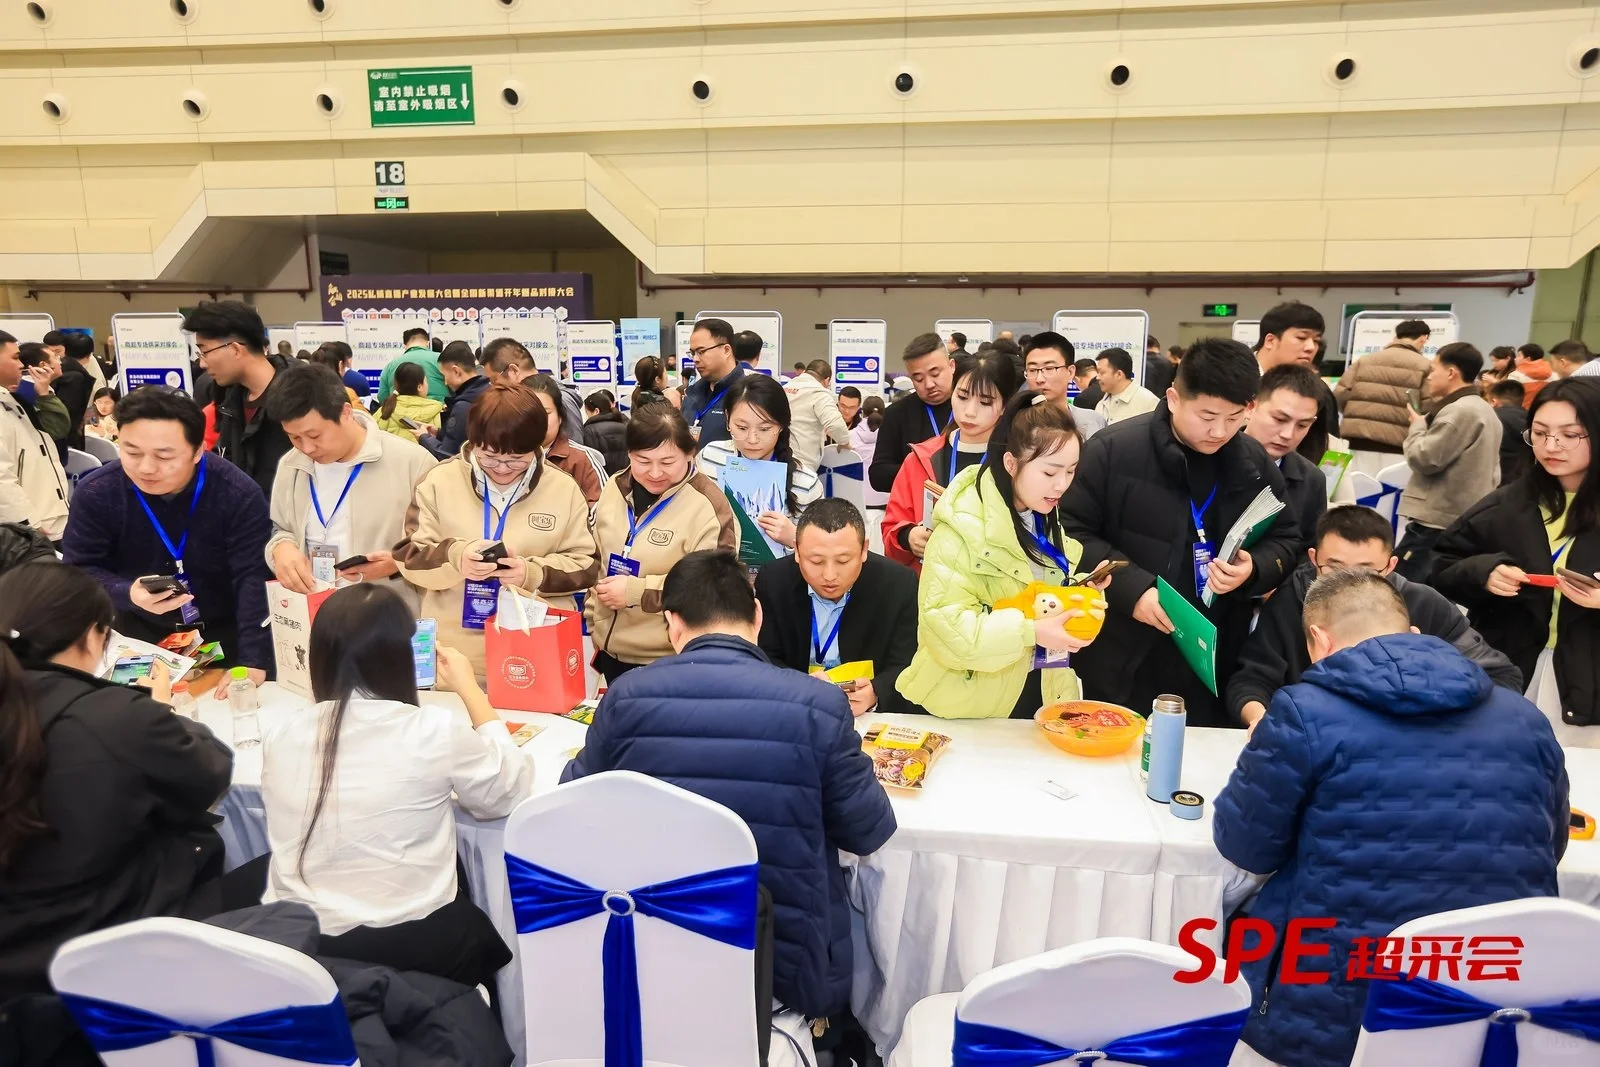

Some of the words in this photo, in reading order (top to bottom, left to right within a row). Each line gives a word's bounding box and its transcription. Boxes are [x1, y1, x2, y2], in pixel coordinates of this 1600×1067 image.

[378, 84, 451, 98] 室内禁止吸烟
[373, 98, 458, 112] 请至室外吸烟区
[376, 163, 404, 184] 18
